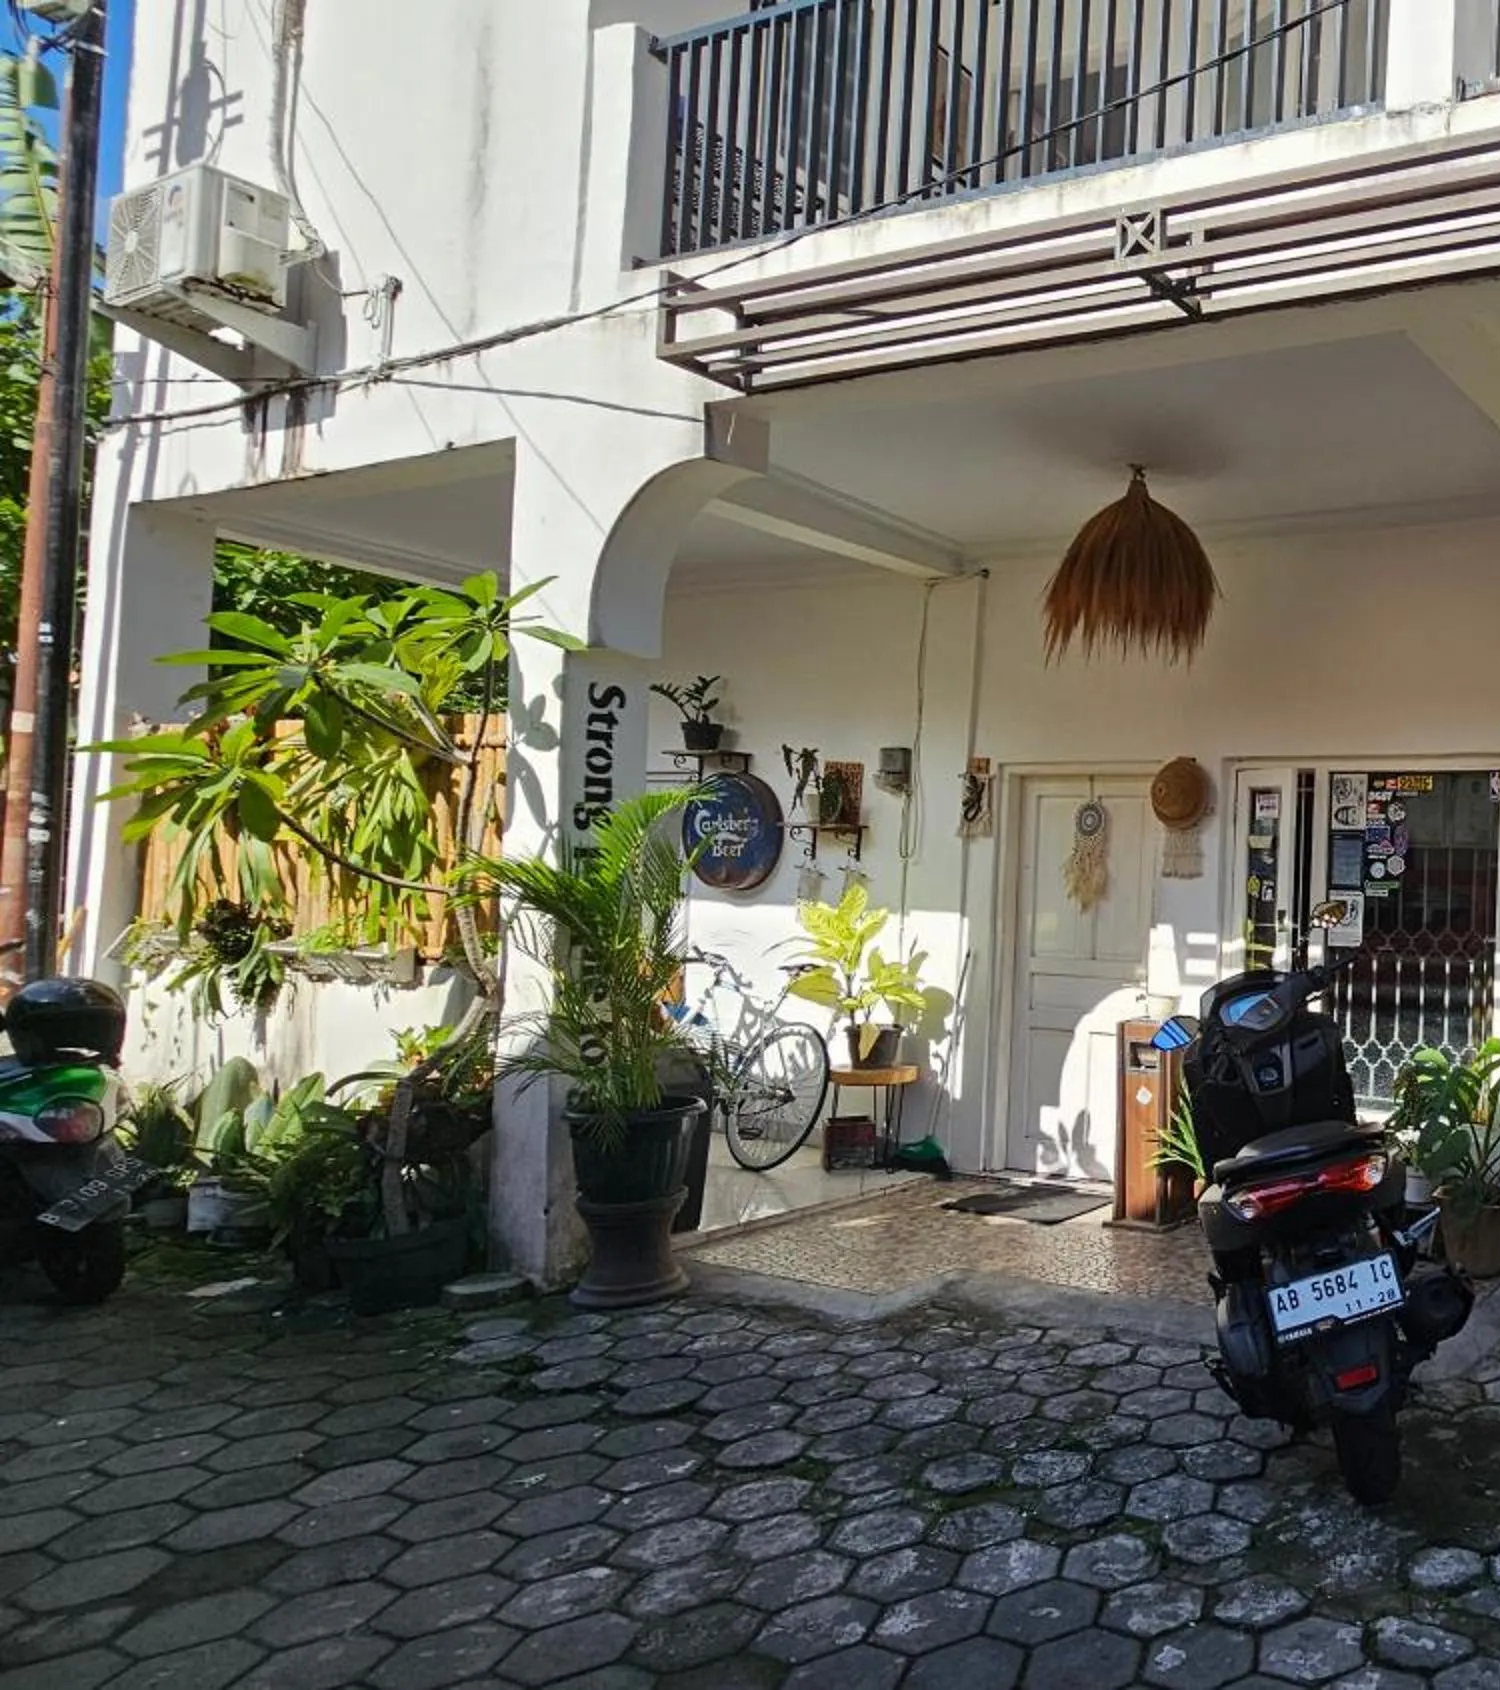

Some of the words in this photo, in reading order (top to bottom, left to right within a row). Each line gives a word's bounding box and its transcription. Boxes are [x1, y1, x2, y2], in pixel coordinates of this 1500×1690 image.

[694, 809, 760, 842] Carlsberg
[712, 841, 746, 858] Beer
[1276, 1289, 1300, 1315] AB
[1311, 1273, 1359, 1303] 5684
[1371, 1260, 1394, 1284] IC
